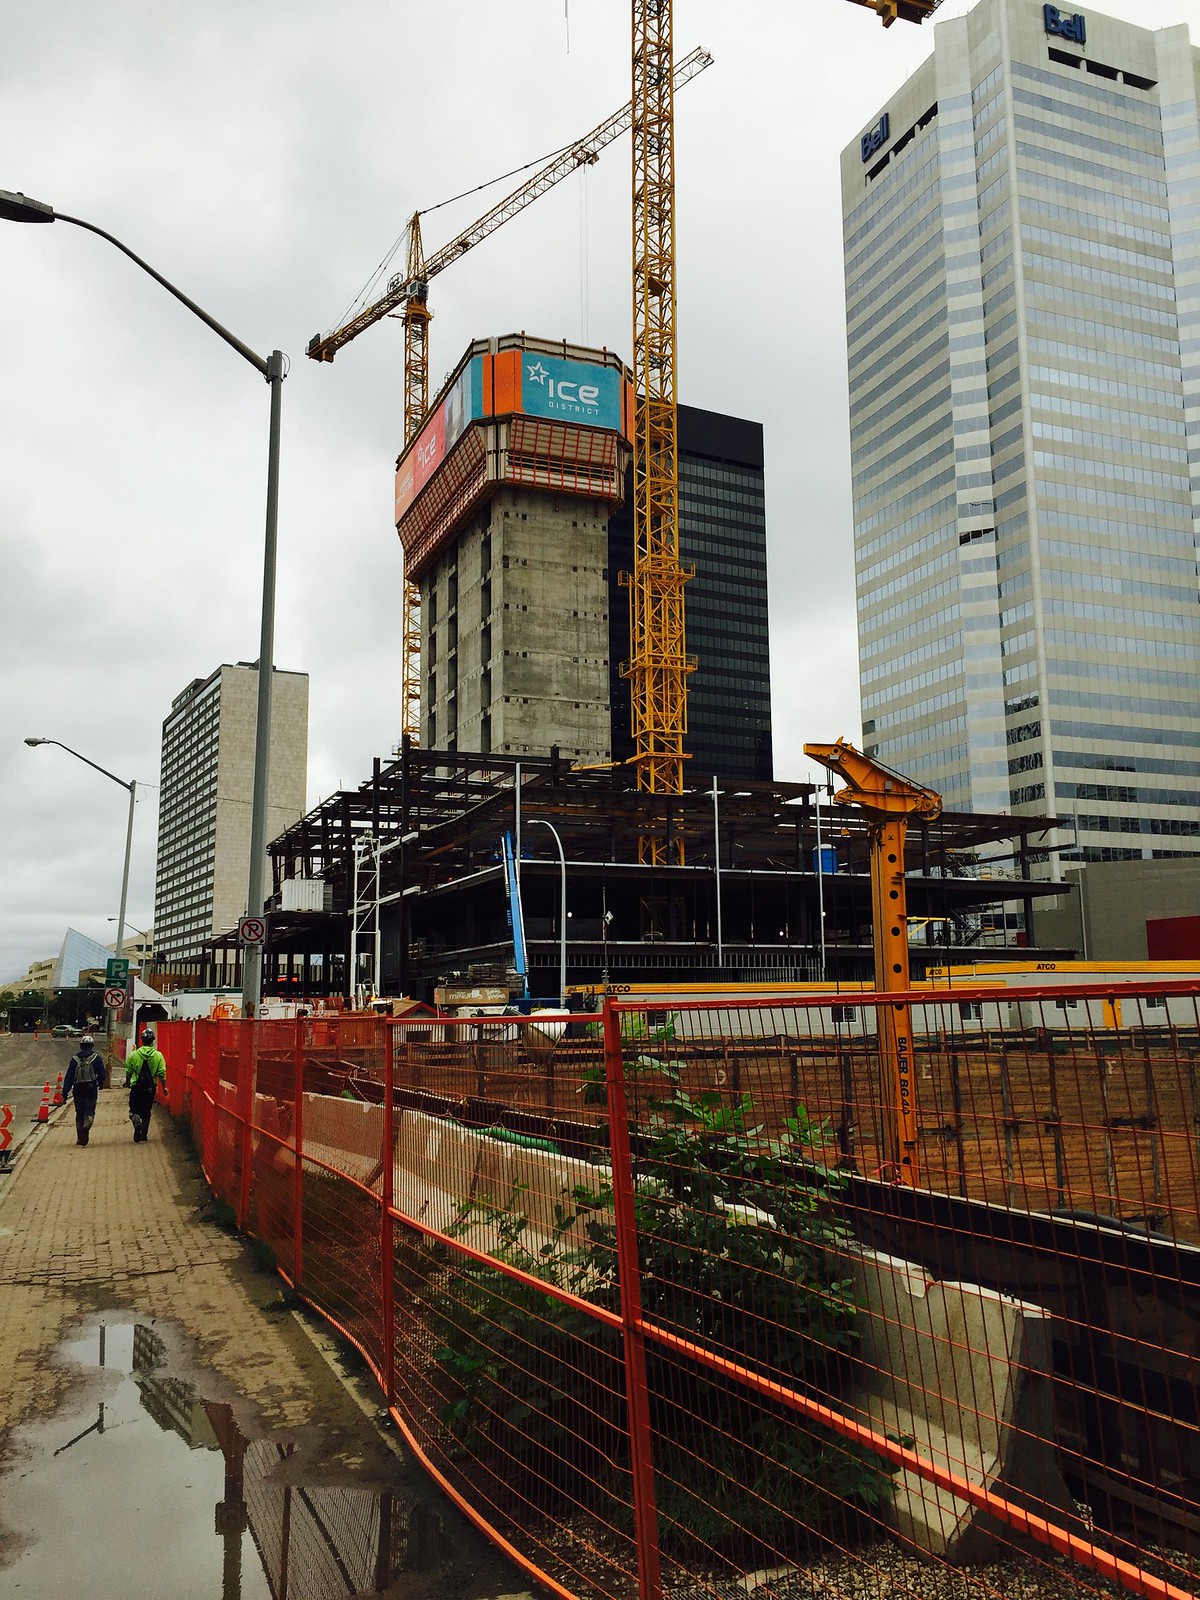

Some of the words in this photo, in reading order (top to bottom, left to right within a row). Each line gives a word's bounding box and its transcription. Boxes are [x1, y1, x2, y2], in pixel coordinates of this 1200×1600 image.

[1043, 3, 1086, 45] Bell
[861, 112, 889, 163] Bell
[548, 401, 600, 416] DISTRICT
[111, 961, 125, 977] P
[929, 968, 943, 976] ATCO
[1036, 963, 1056, 971] ATCO
[606, 985, 631, 993] ATCO
[898, 1037, 909, 1075] BAUER
